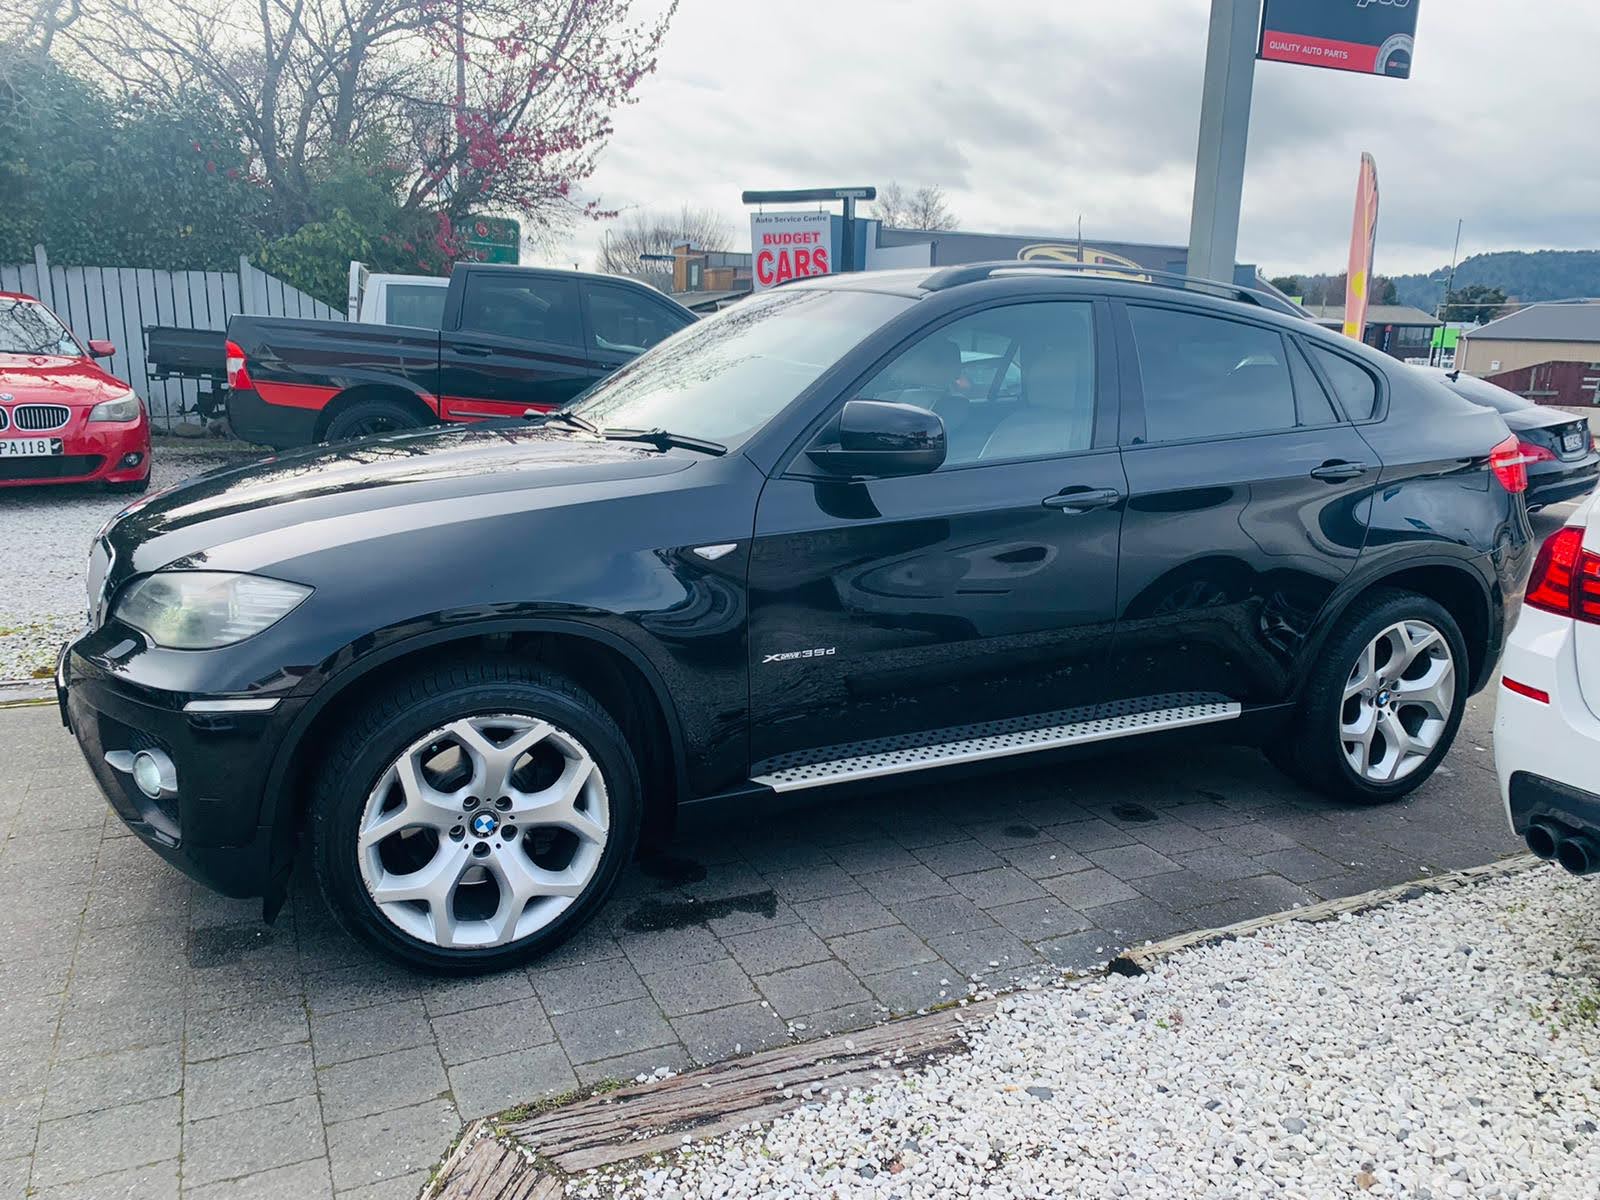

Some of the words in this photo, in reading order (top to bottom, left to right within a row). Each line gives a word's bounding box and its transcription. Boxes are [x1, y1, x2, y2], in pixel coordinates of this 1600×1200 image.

[1269, 40, 1301, 53] QUALITY
[1302, 46, 1322, 56] AUTO
[1324, 49, 1348, 60] PARTS
[803, 215, 827, 223] Centre
[762, 232, 821, 245] BUDGET
[756, 247, 829, 285] CARS
